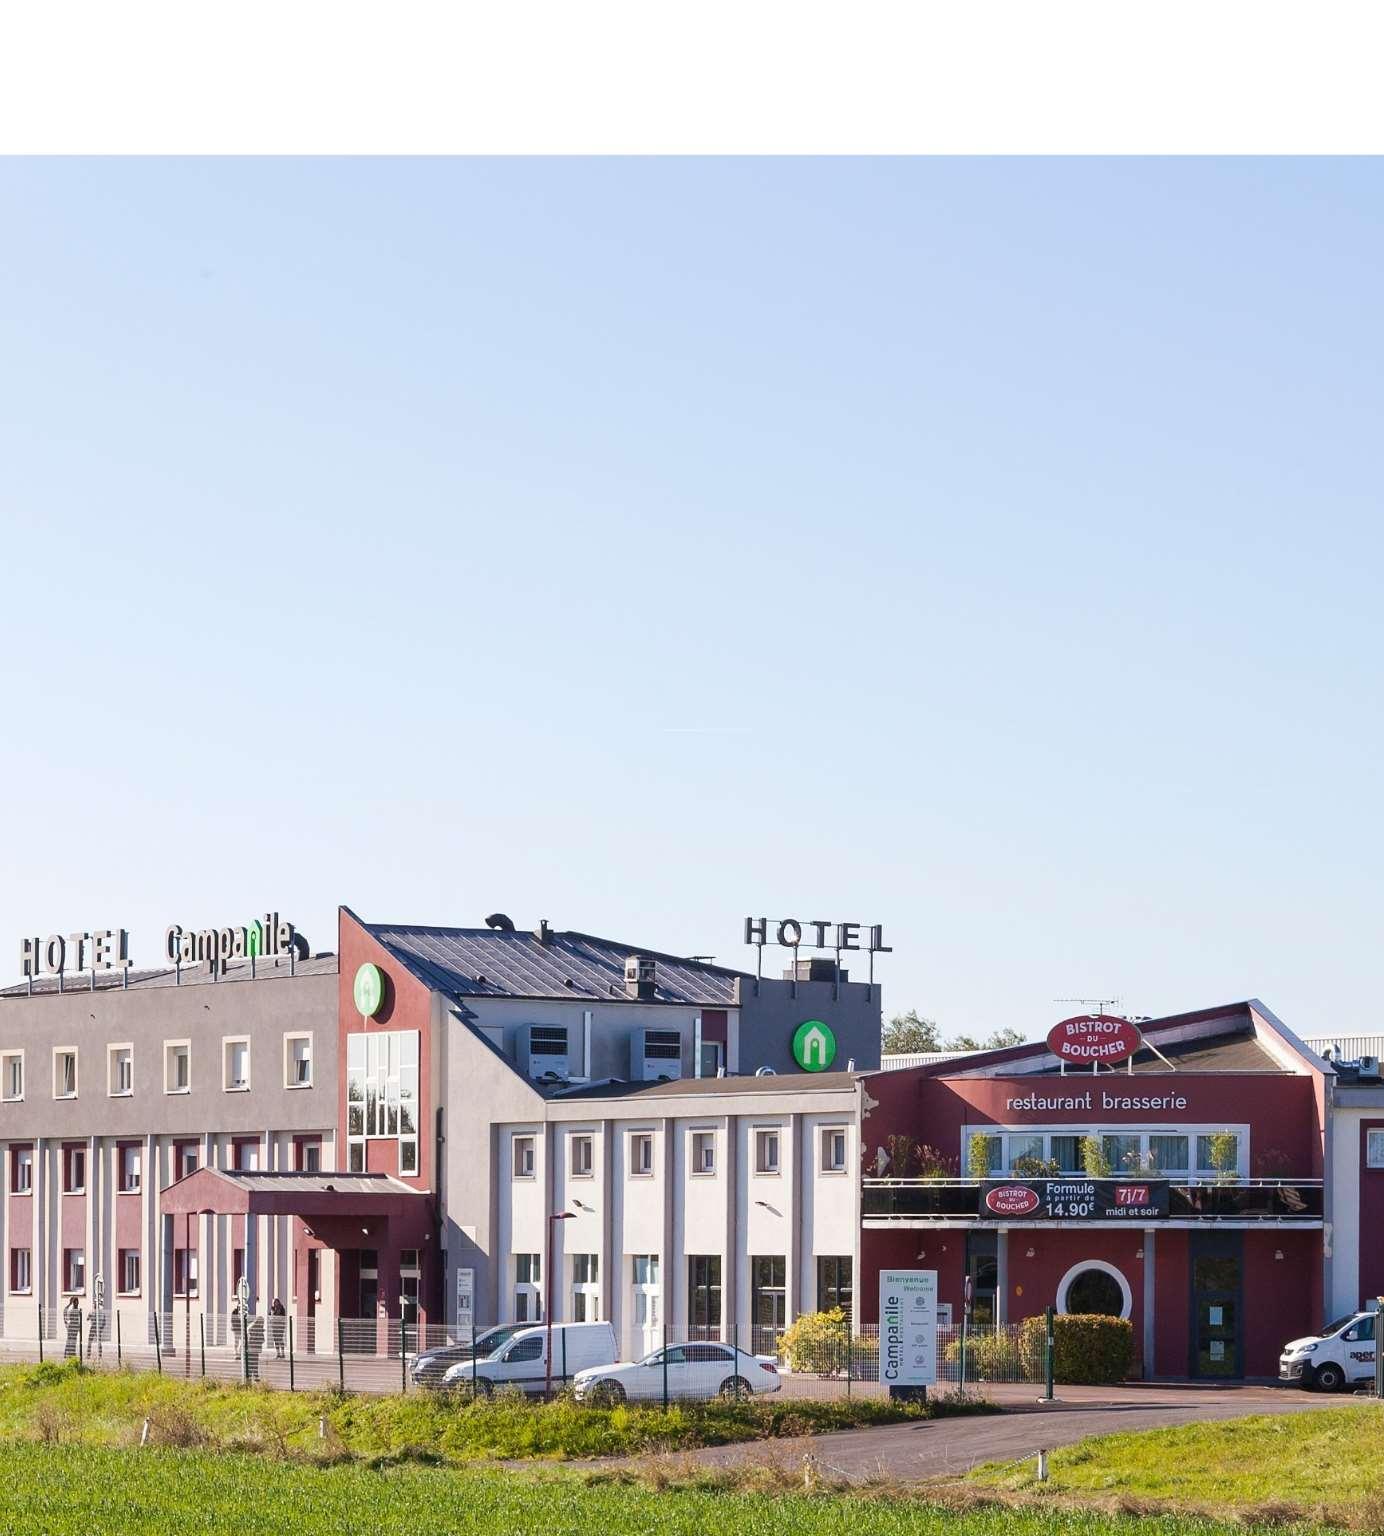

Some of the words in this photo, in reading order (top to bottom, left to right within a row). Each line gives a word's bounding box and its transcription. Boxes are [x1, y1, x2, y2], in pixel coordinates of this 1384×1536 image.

[744, 917, 893, 953] HOTEL
[20, 928, 133, 976] HOTEL
[164, 911, 295, 976] Campanile
[1065, 1021, 1122, 1036] BISTROT
[1061, 1040, 1126, 1057] BOUCHER
[1006, 1091, 1092, 1110] restaurant
[1102, 1091, 1187, 1110] brasserie
[998, 1190, 1028, 1198] BISTROT
[1046, 1182, 1095, 1194] Formule
[1118, 1188, 1146, 1204] 7j/7
[996, 1200, 1030, 1211] BOUCHER
[1046, 1202, 1095, 1217] 14.90€
[1105, 1207, 1127, 1216] midi
[1129, 1208, 1139, 1216] et
[1141, 1207, 1159, 1216] soir
[885, 1296, 903, 1380] Campanile
